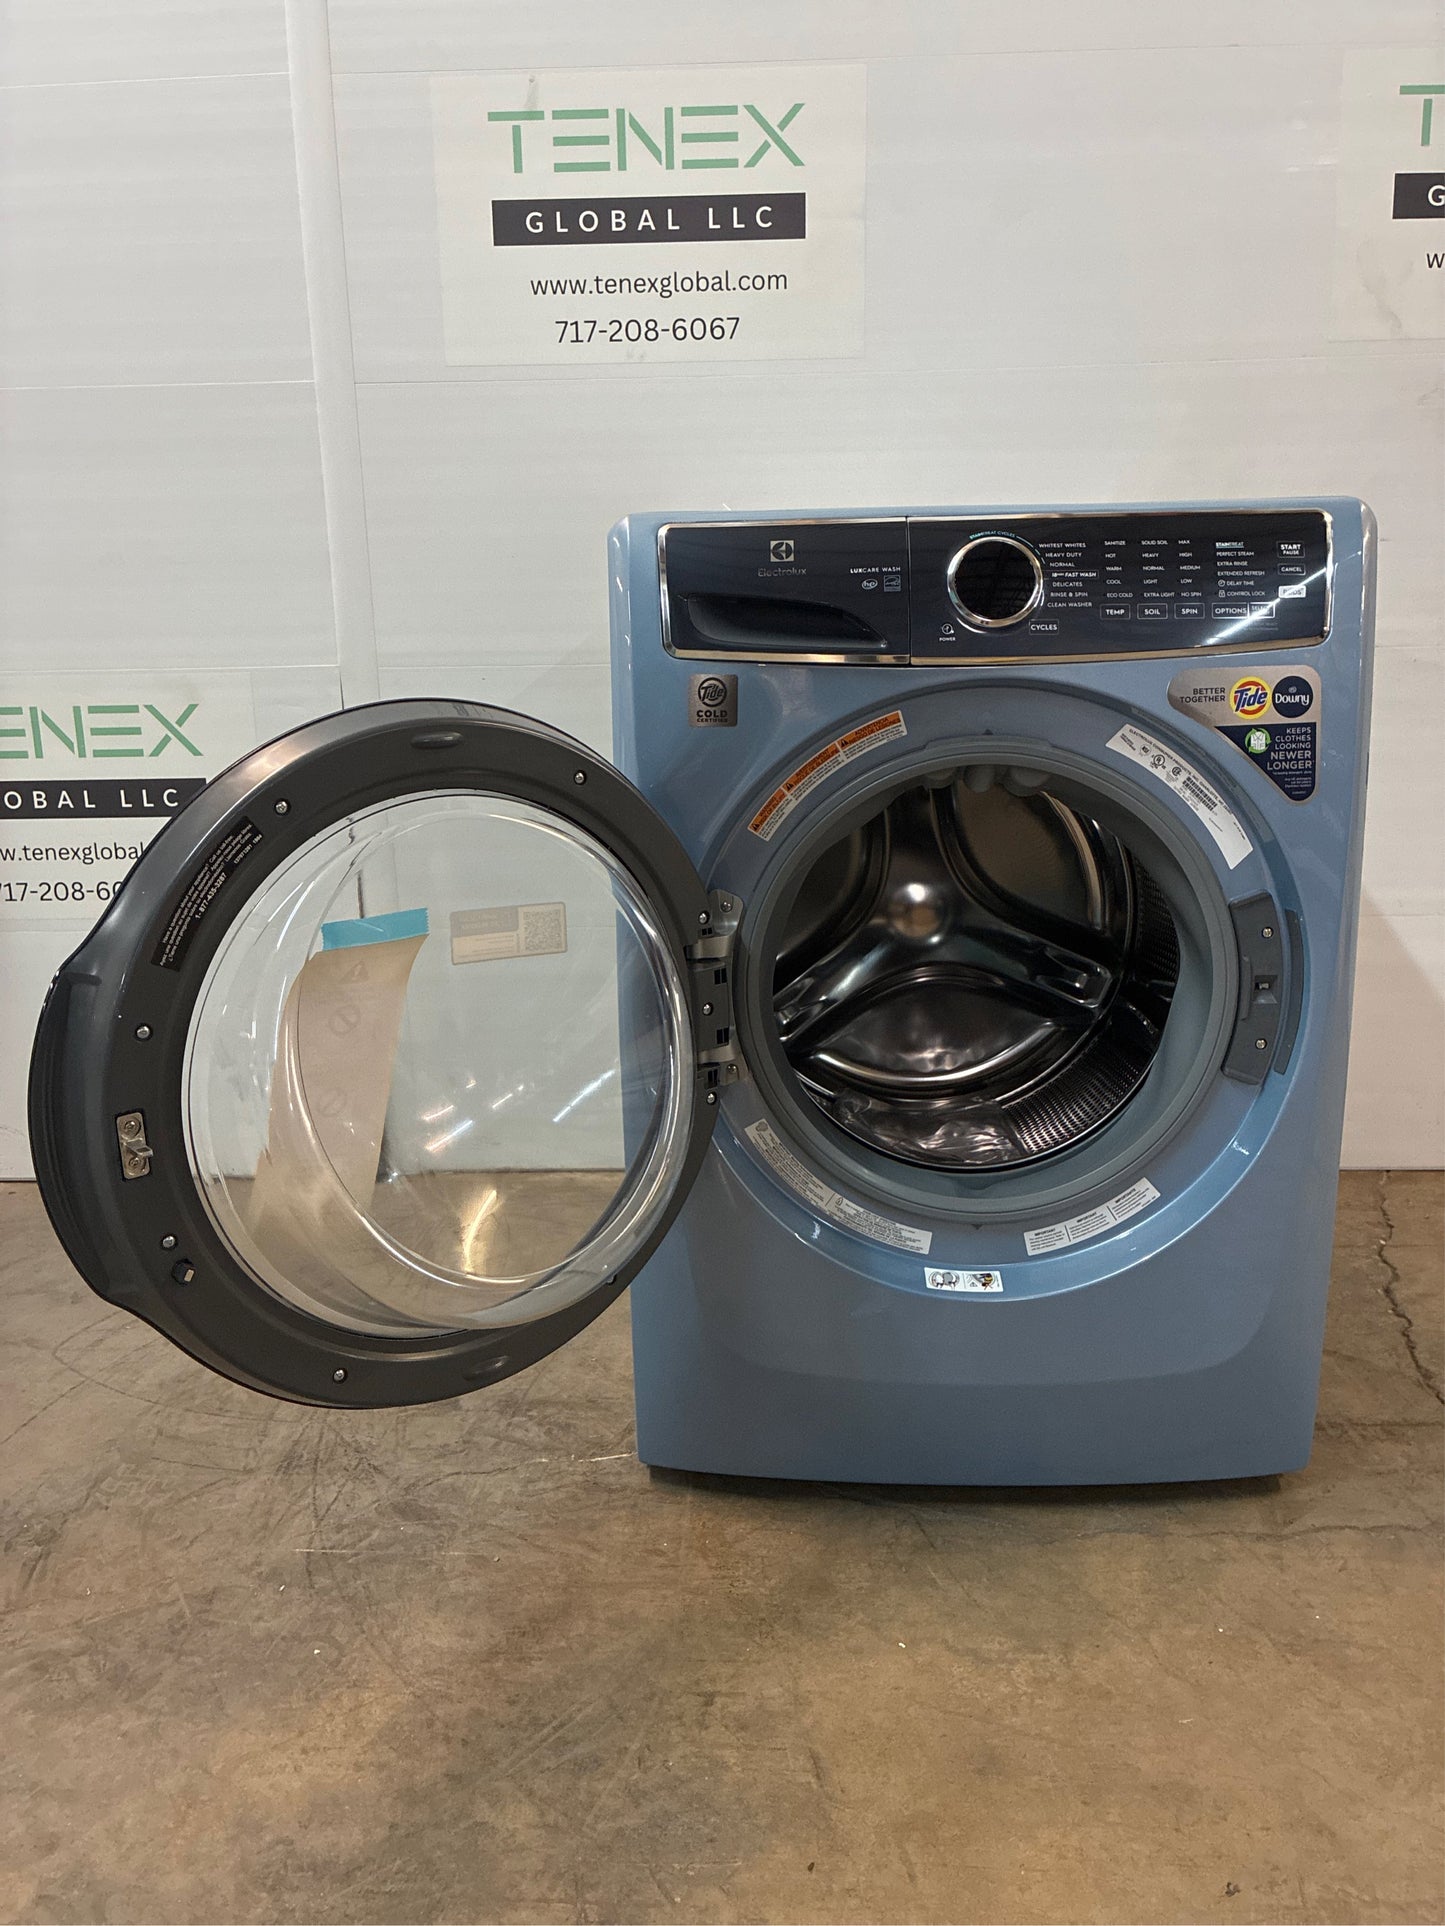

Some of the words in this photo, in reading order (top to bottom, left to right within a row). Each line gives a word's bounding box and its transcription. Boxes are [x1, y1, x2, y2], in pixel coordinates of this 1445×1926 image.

[487, 103, 806, 173] TENEX
[526, 208, 680, 233] GLOBAL
[708, 205, 773, 229] LLC
[530, 270, 788, 299] www.tenexglobal.com
[555, 317, 740, 344] 717-208-6067
[757, 567, 807, 577] Electrolux
[1030, 623, 1058, 631] CYCLES
[701, 684, 724, 701] Tide
[1193, 687, 1226, 695] BETTER
[1180, 695, 1226, 703] TOGETHER
[1234, 688, 1267, 712] Tide
[1275, 693, 1310, 706] Downy
[697, 710, 728, 718] COLD
[1275, 742, 1311, 750] LOOKING
[1270, 750, 1311, 760] NEWER
[120, 788, 179, 808] LLC
[0, 881, 123, 902] 17-208-6
